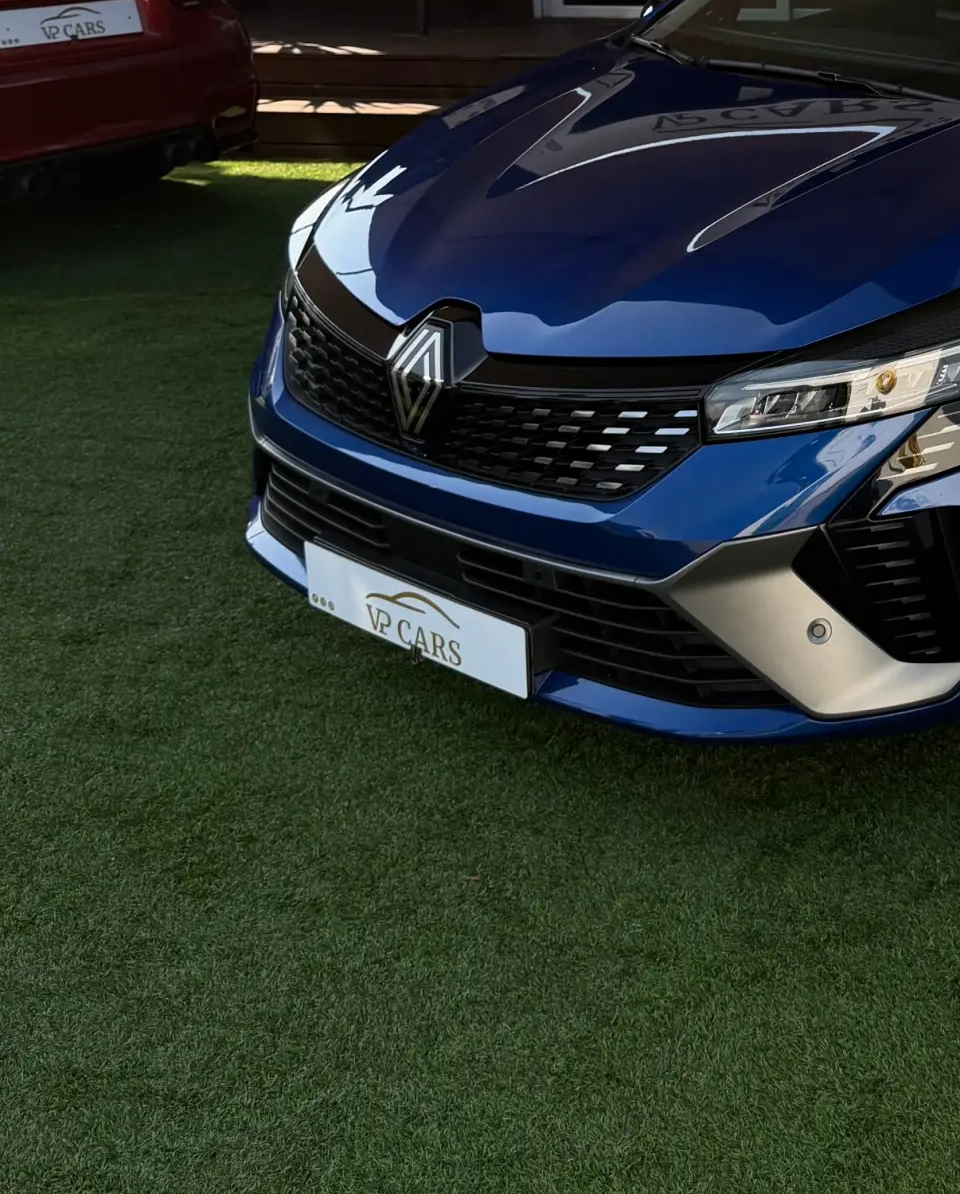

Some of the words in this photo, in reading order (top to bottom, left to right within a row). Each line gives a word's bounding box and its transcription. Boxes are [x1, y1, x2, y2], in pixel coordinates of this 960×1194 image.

[41, 26, 60, 40] VP
[63, 20, 106, 38] CARS
[366, 604, 392, 635] VP
[397, 619, 463, 666] CARS
